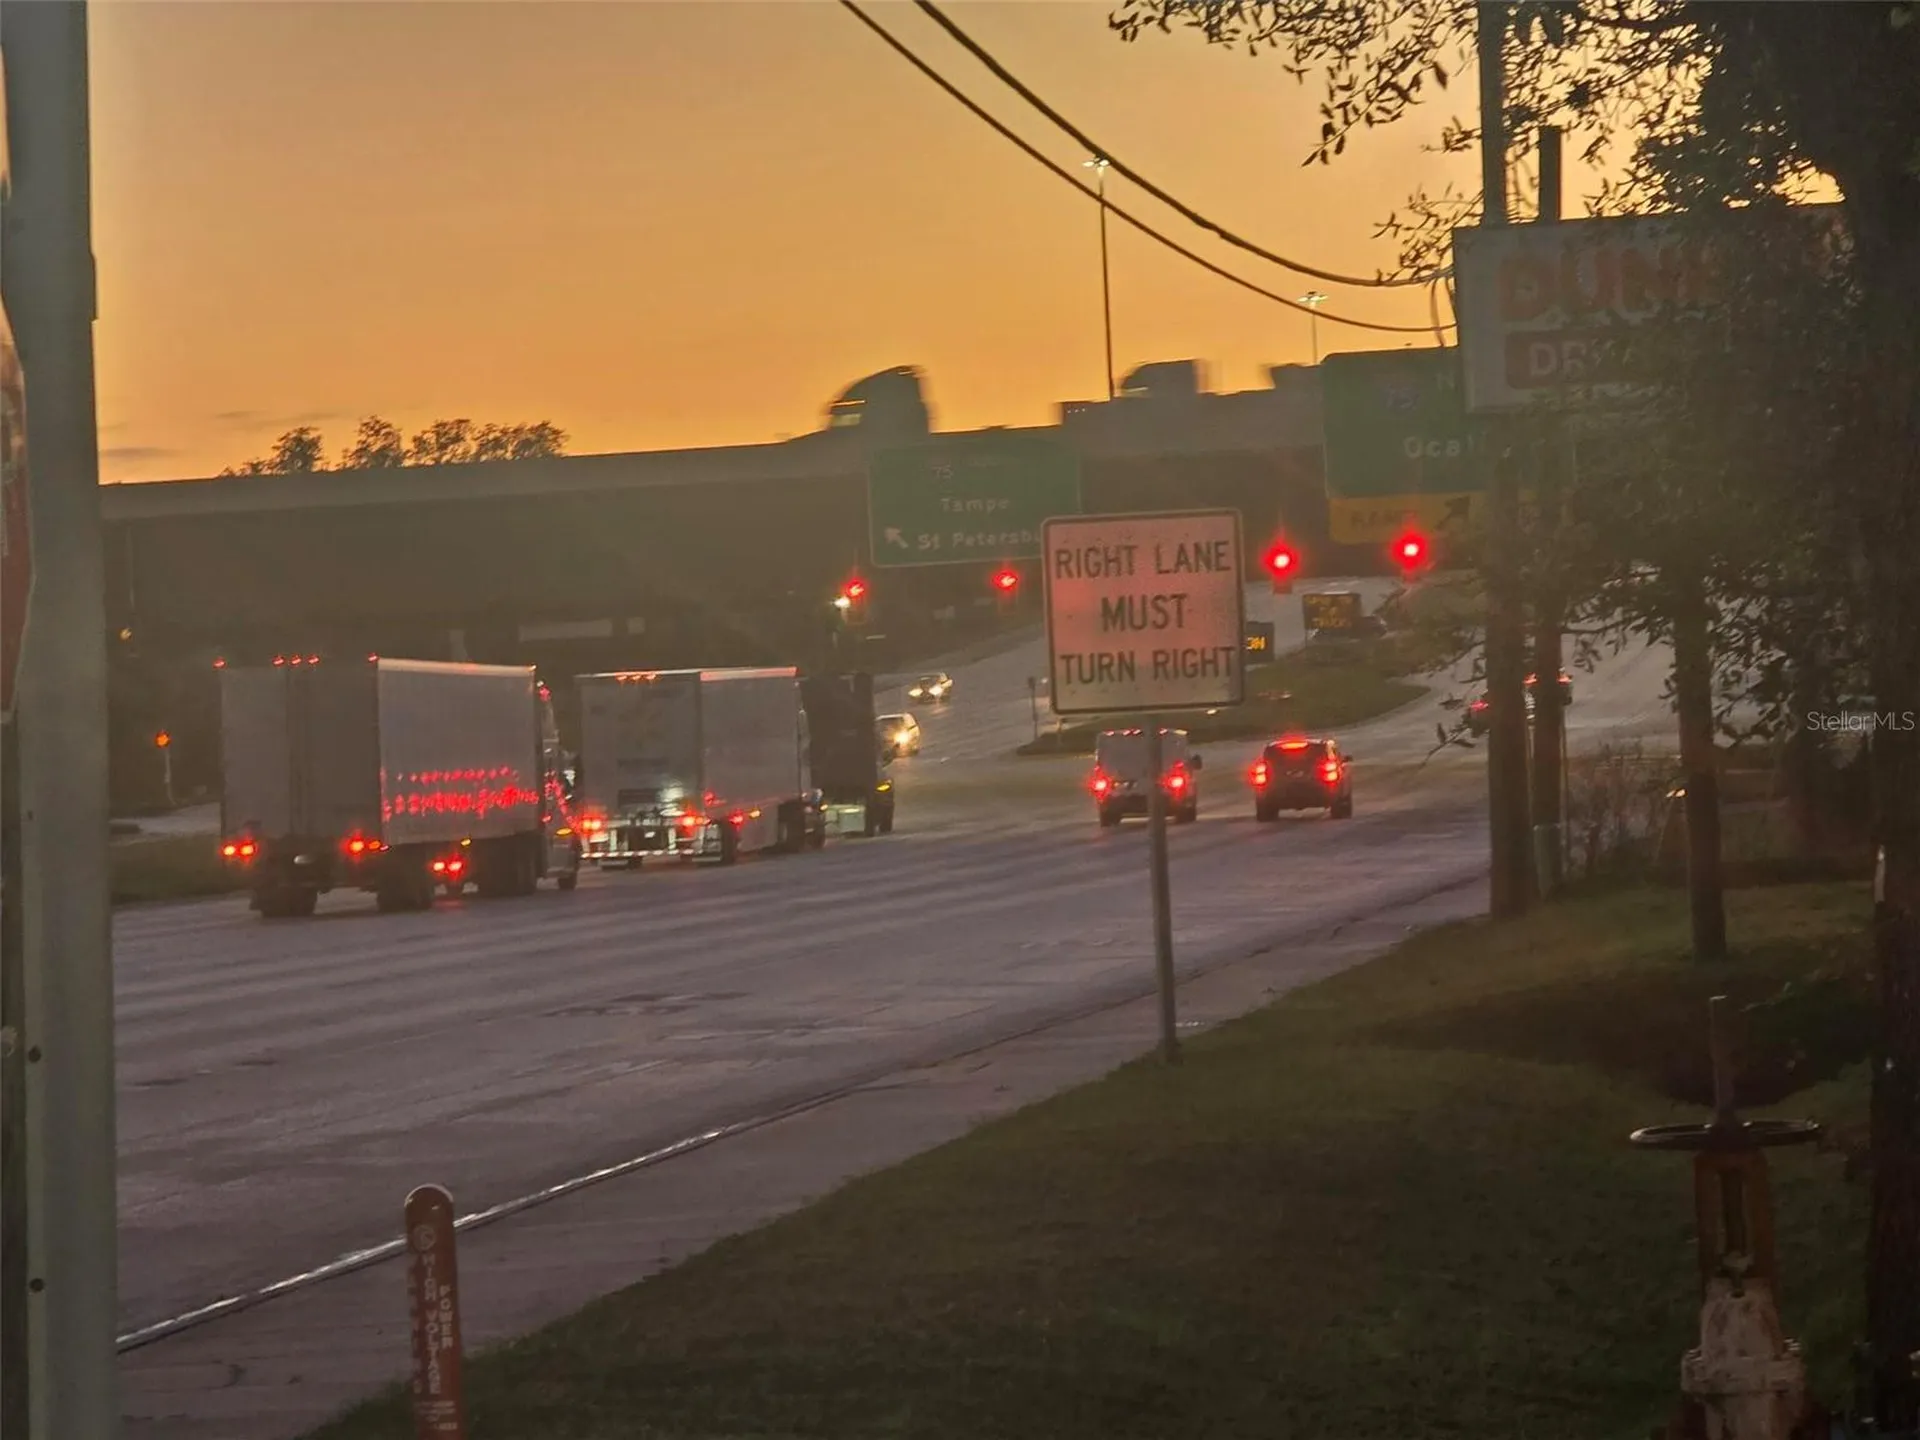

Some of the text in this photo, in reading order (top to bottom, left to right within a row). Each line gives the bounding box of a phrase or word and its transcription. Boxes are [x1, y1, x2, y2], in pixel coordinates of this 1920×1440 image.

[1403, 432, 1488, 458] Ocal
[1055, 541, 1231, 579] RIGHT LANE
[1101, 594, 1188, 632] MUST
[1060, 646, 1236, 685] TURN RIGHT
